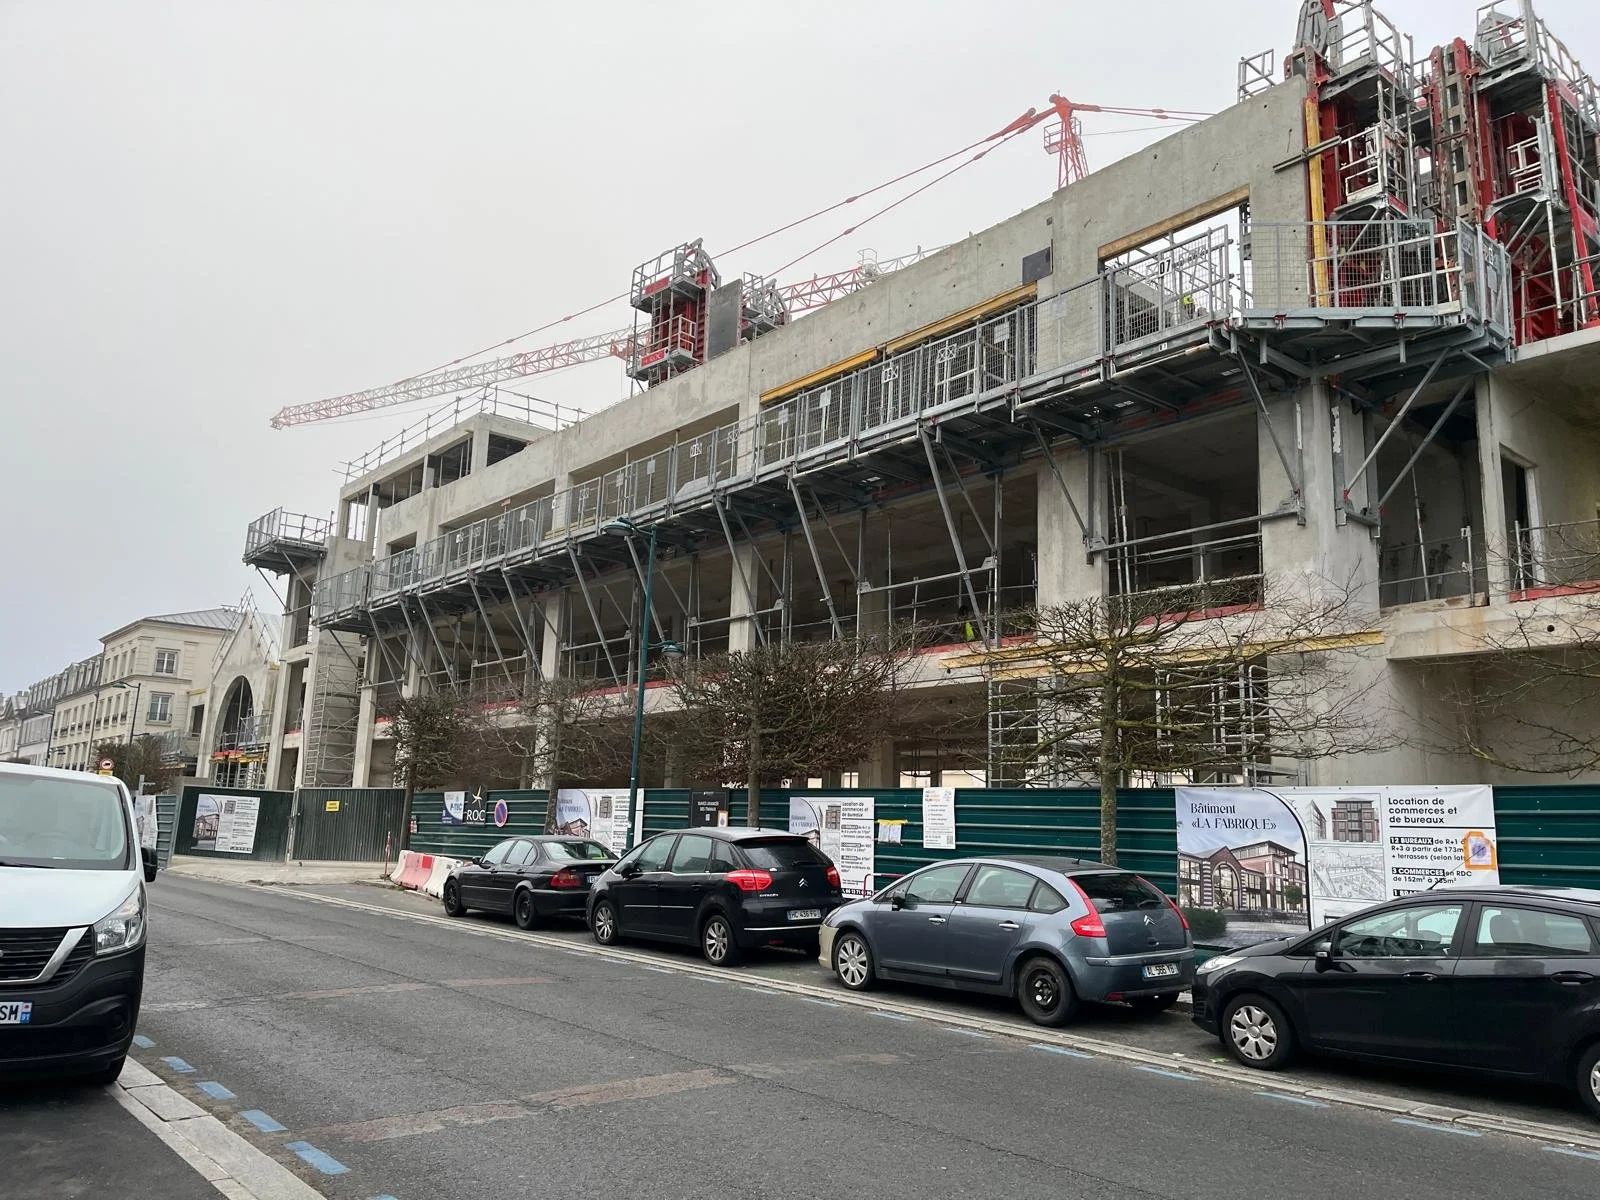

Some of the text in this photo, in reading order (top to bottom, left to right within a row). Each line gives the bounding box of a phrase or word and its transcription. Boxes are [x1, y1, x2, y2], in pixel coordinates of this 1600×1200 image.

[1160, 259, 1171, 275] 07
[1388, 797, 1445, 806] Location de
[1191, 802, 1236, 814] Bâtiment
[1388, 807, 1457, 815] commerces et
[466, 809, 486, 821] ROC
[1389, 816, 1445, 824] de bureaux
[1400, 837, 1433, 845] BUREAUX
[1398, 868, 1444, 876] COMMERCES
